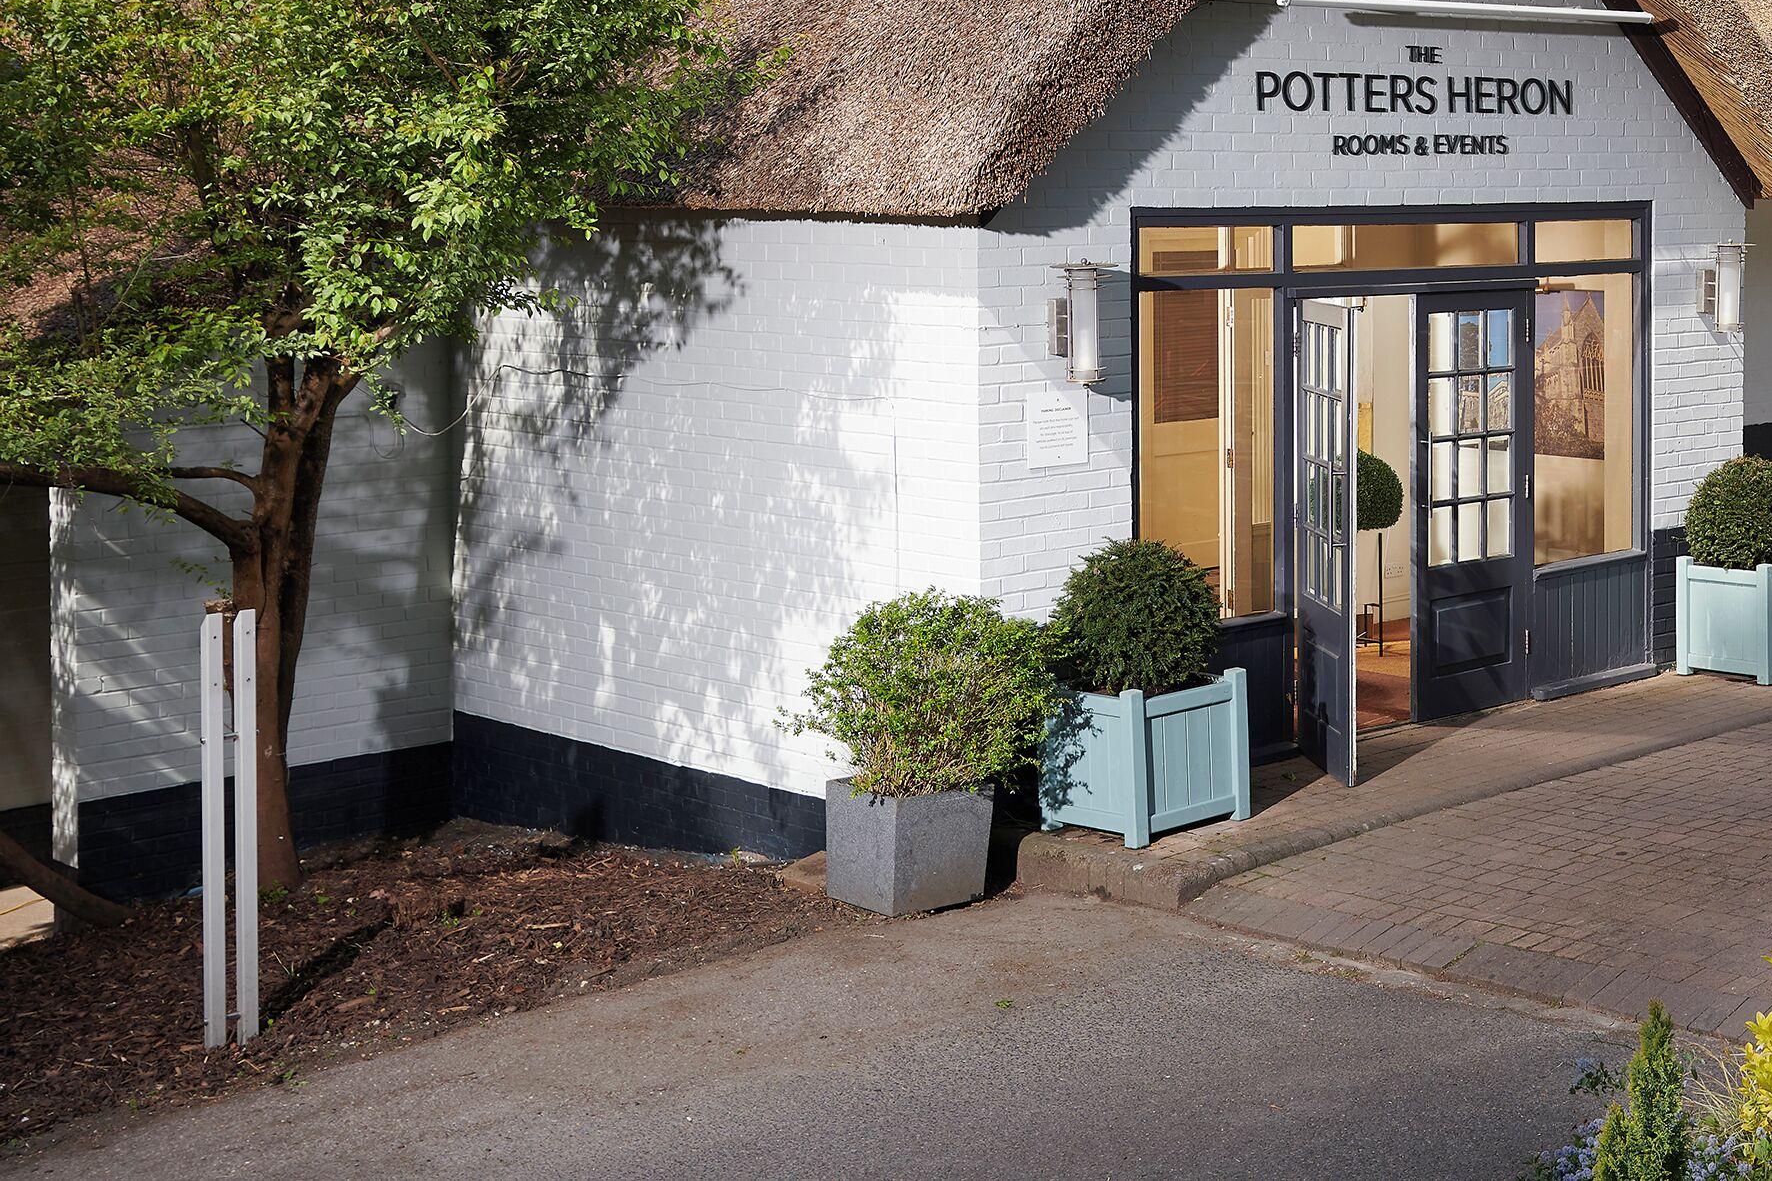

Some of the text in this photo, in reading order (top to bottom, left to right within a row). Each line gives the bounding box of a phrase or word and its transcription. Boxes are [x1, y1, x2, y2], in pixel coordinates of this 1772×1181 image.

[1405, 45, 1443, 64] THE
[1255, 70, 1574, 115] POTTERS HERON
[1332, 134, 1509, 156] ROOMS & EVENTS
